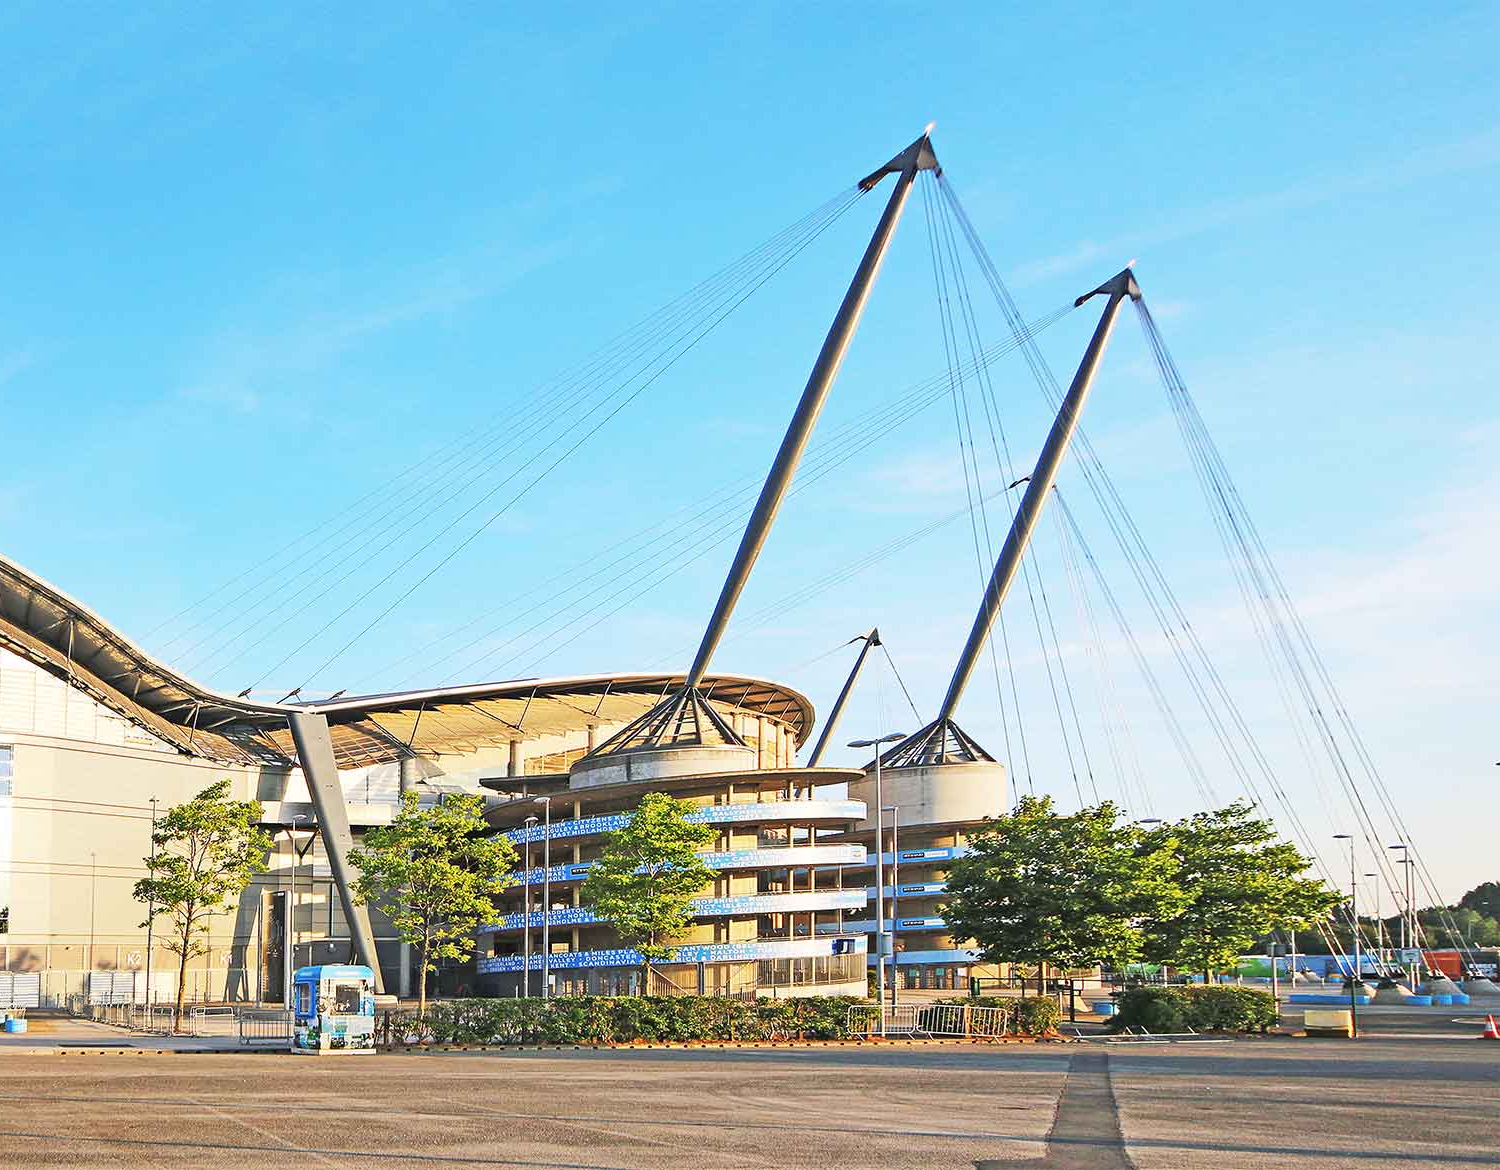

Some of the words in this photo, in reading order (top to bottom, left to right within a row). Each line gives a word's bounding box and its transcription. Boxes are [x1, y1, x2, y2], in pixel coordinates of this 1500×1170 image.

[542, 827, 572, 835] BGULEY
[580, 820, 631, 829] BROOKLAND
[534, 875, 566, 884] CHADLE
[127, 953, 141, 965] K2
